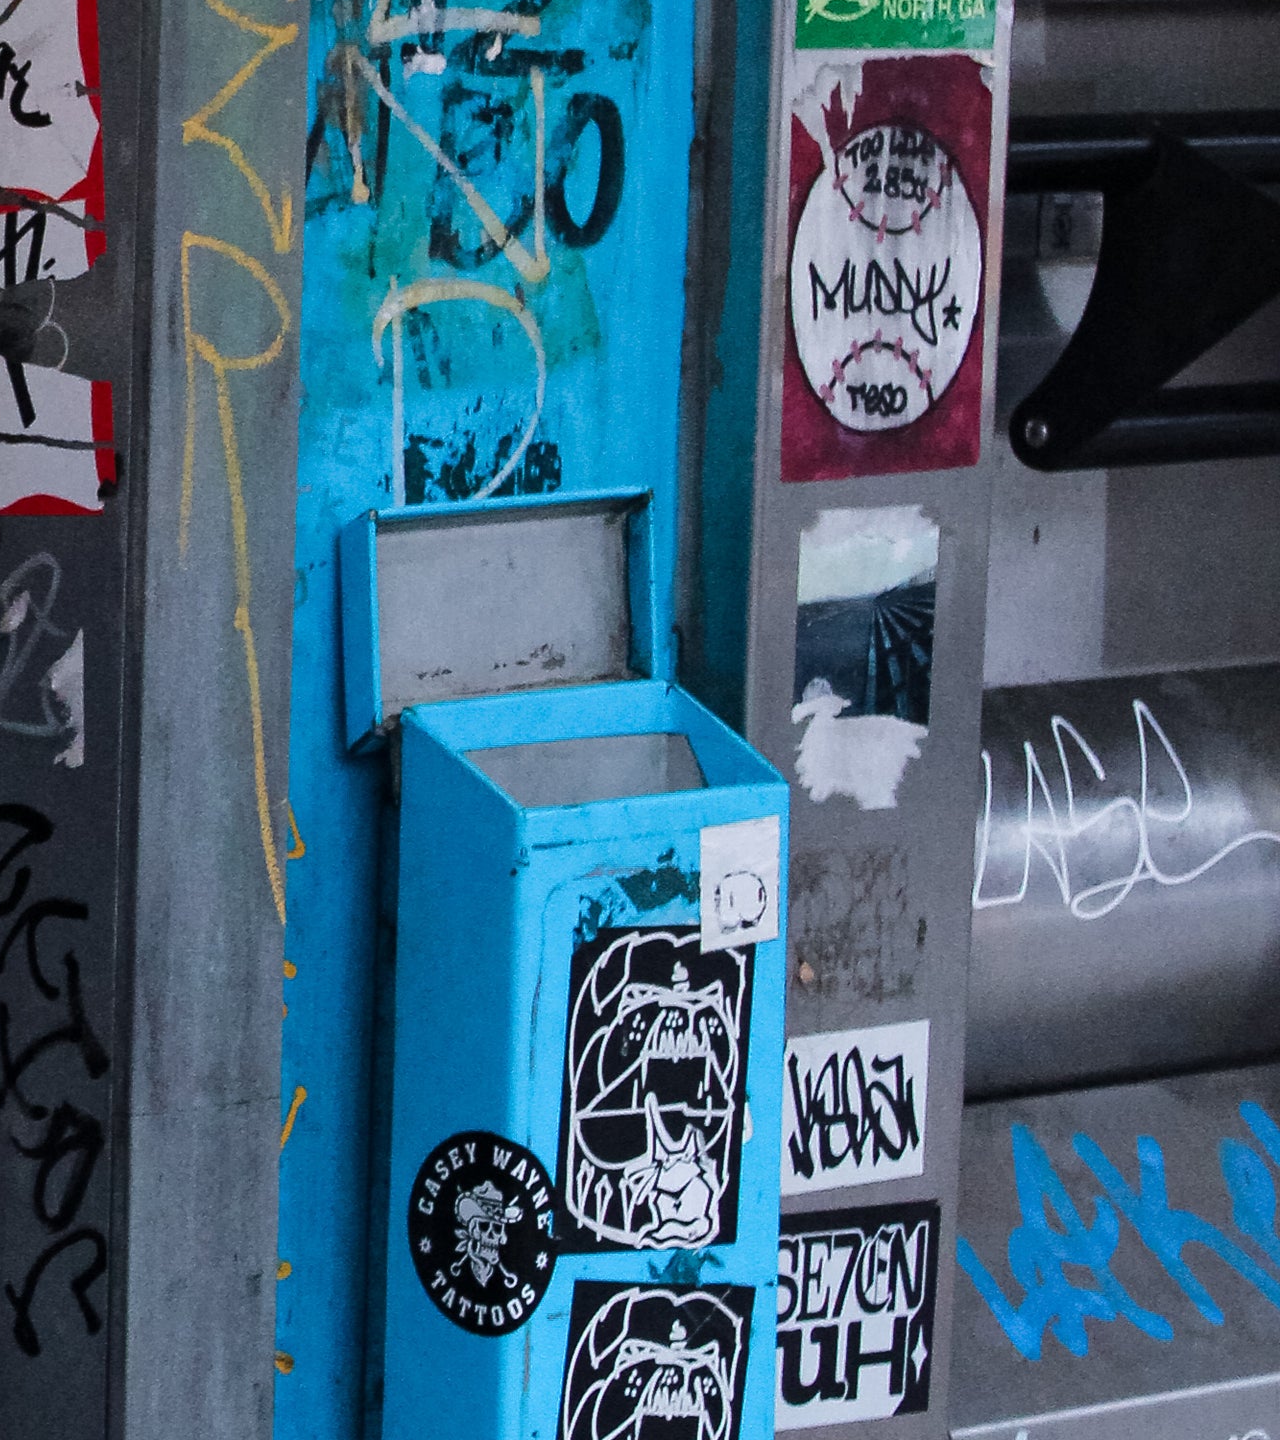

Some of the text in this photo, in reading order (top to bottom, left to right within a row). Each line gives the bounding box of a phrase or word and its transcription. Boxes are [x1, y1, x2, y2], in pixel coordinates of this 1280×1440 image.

[809, 256, 952, 346] MUDDY
[417, 1142, 554, 1231] CASEY WAYNE
[430, 1270, 536, 1327] TATTOOS
